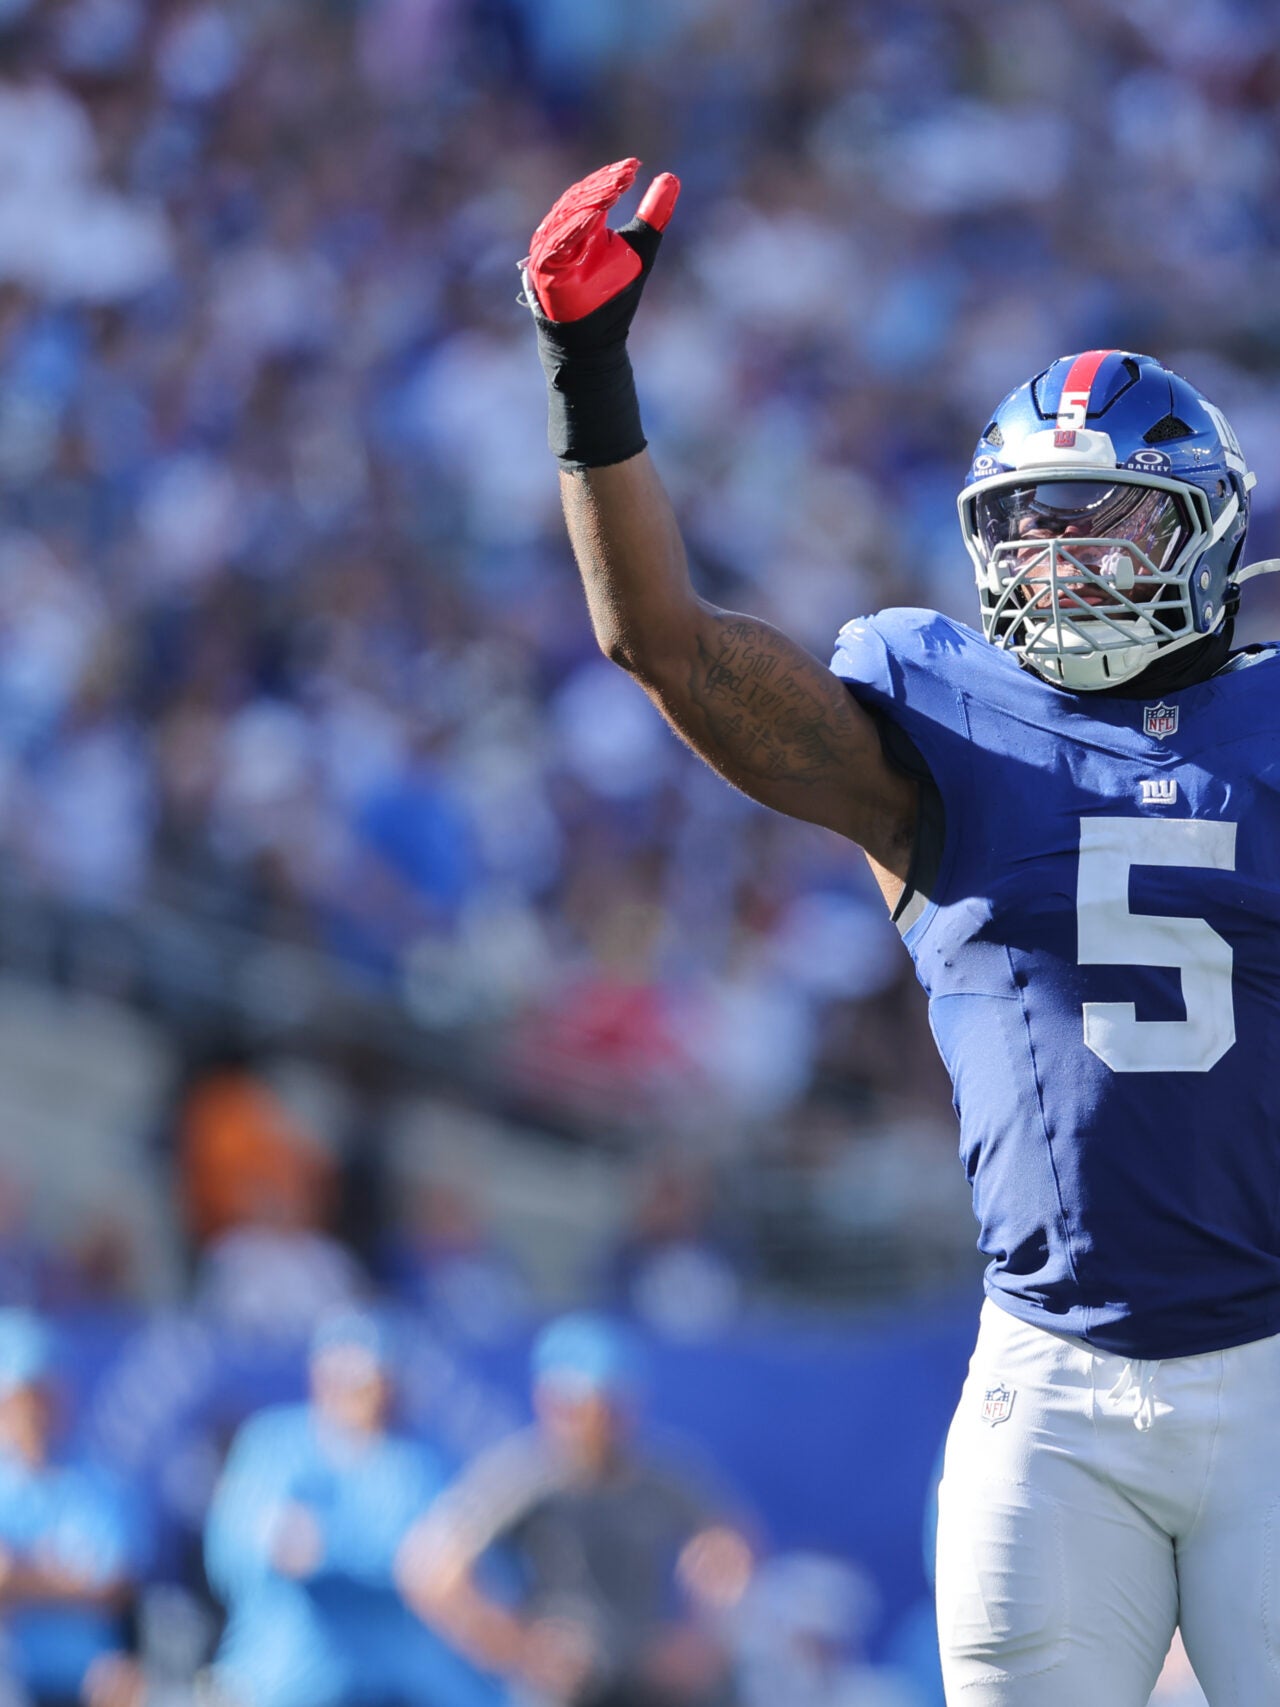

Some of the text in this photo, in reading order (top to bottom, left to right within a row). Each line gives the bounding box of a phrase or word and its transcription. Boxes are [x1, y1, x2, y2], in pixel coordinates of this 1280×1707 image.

[1057, 391, 1091, 429] 5
[1127, 463, 1170, 472] OAKLEY
[1149, 717, 1173, 732] NFL
[1076, 816, 1238, 1073] 5
[985, 1402, 1006, 1417] NFL
